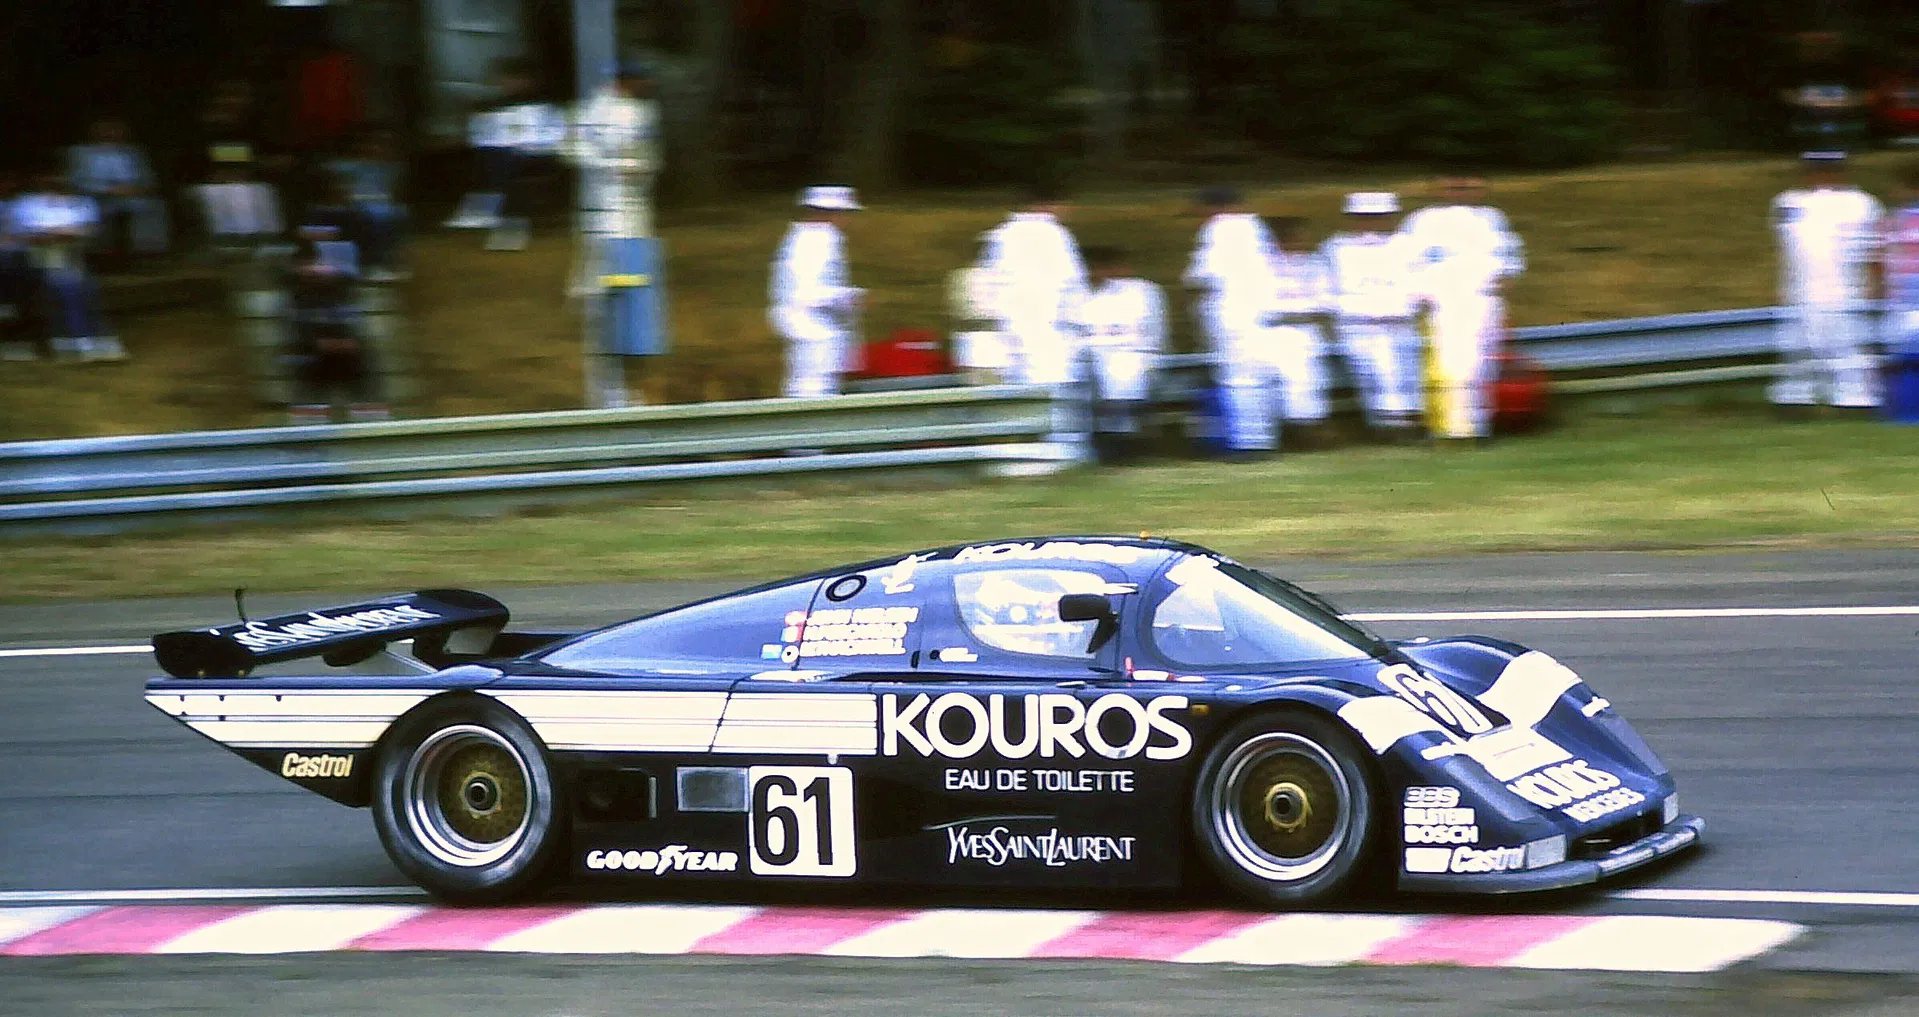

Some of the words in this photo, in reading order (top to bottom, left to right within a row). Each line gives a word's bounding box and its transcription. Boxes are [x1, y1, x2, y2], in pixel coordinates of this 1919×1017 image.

[882, 692, 1193, 760] KOUROS
[282, 752, 354, 778] Castrol
[945, 768, 990, 791] EAU
[996, 768, 1028, 791] DE
[1032, 768, 1136, 792] TOILETTE
[752, 774, 834, 866] 61
[1404, 825, 1479, 844] BOSCH
[586, 845, 739, 876] GOODYEAR
